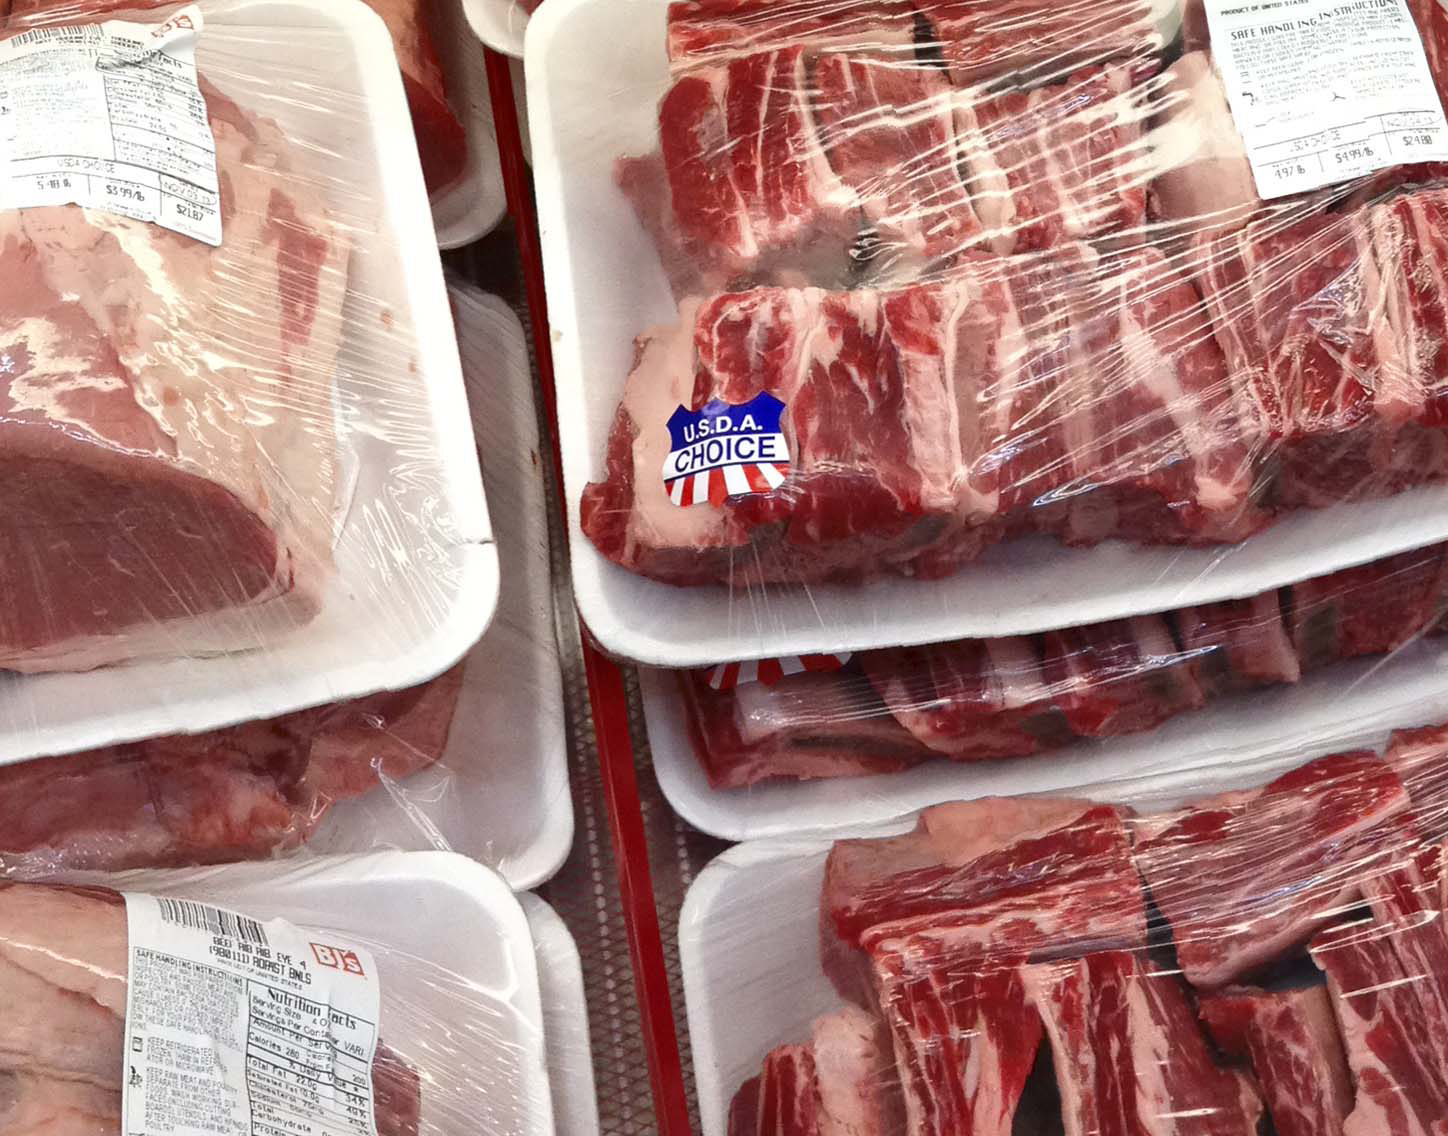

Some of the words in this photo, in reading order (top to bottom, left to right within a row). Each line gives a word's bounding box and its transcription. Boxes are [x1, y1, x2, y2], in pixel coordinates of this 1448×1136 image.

[1231, 27, 1256, 41] SAFE
[1260, 17, 1318, 36] HANDLING
[684, 414, 762, 443] U.S.D.A.
[674, 435, 776, 473] CHOICE
[268, 988, 321, 1016] Nutrition
[249, 1032, 283, 1051] Calories
